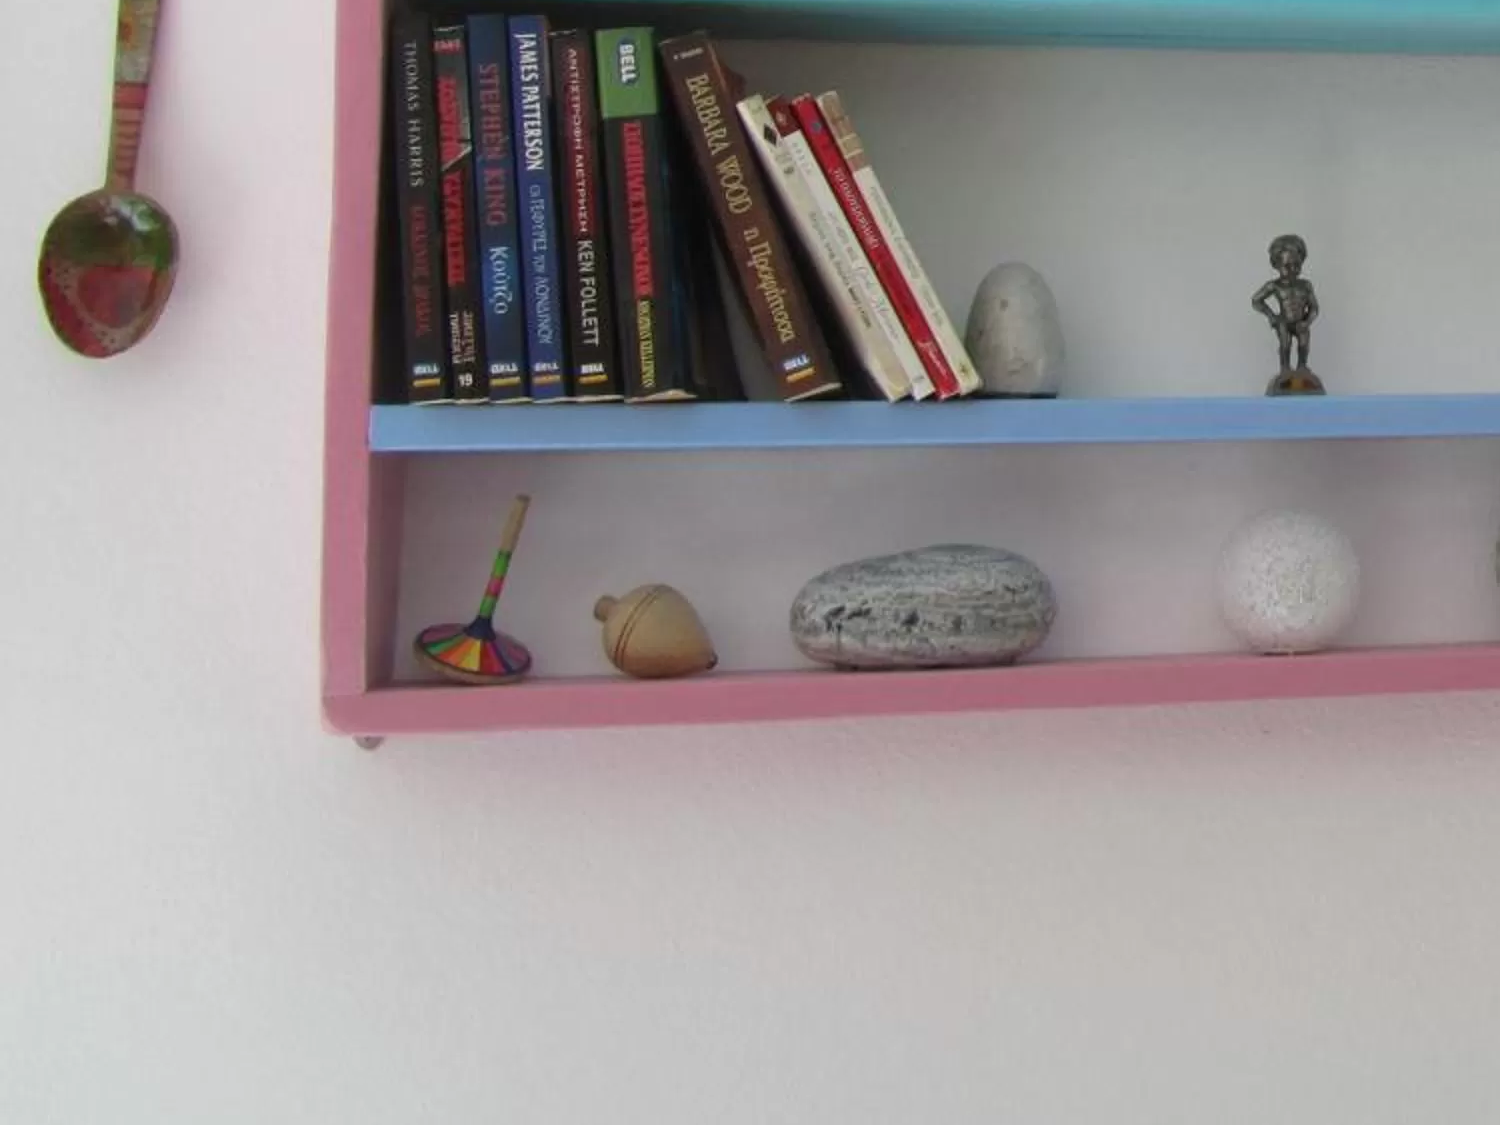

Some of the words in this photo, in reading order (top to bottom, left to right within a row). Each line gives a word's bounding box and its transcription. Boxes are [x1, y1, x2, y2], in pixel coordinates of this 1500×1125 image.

[403, 42, 420, 112] THOMAS
[513, 33, 539, 82] JAMES
[618, 43, 638, 84] BELL
[478, 62, 504, 161] STEPHEN
[518, 85, 545, 172] PATTERSON
[686, 73, 731, 156] BARBARA
[716, 154, 752, 215] WOOD
[408, 119, 424, 188] HARRIS
[484, 166, 509, 228] KING
[576, 239, 595, 273] KEN
[580, 277, 600, 347] FOLLETT
